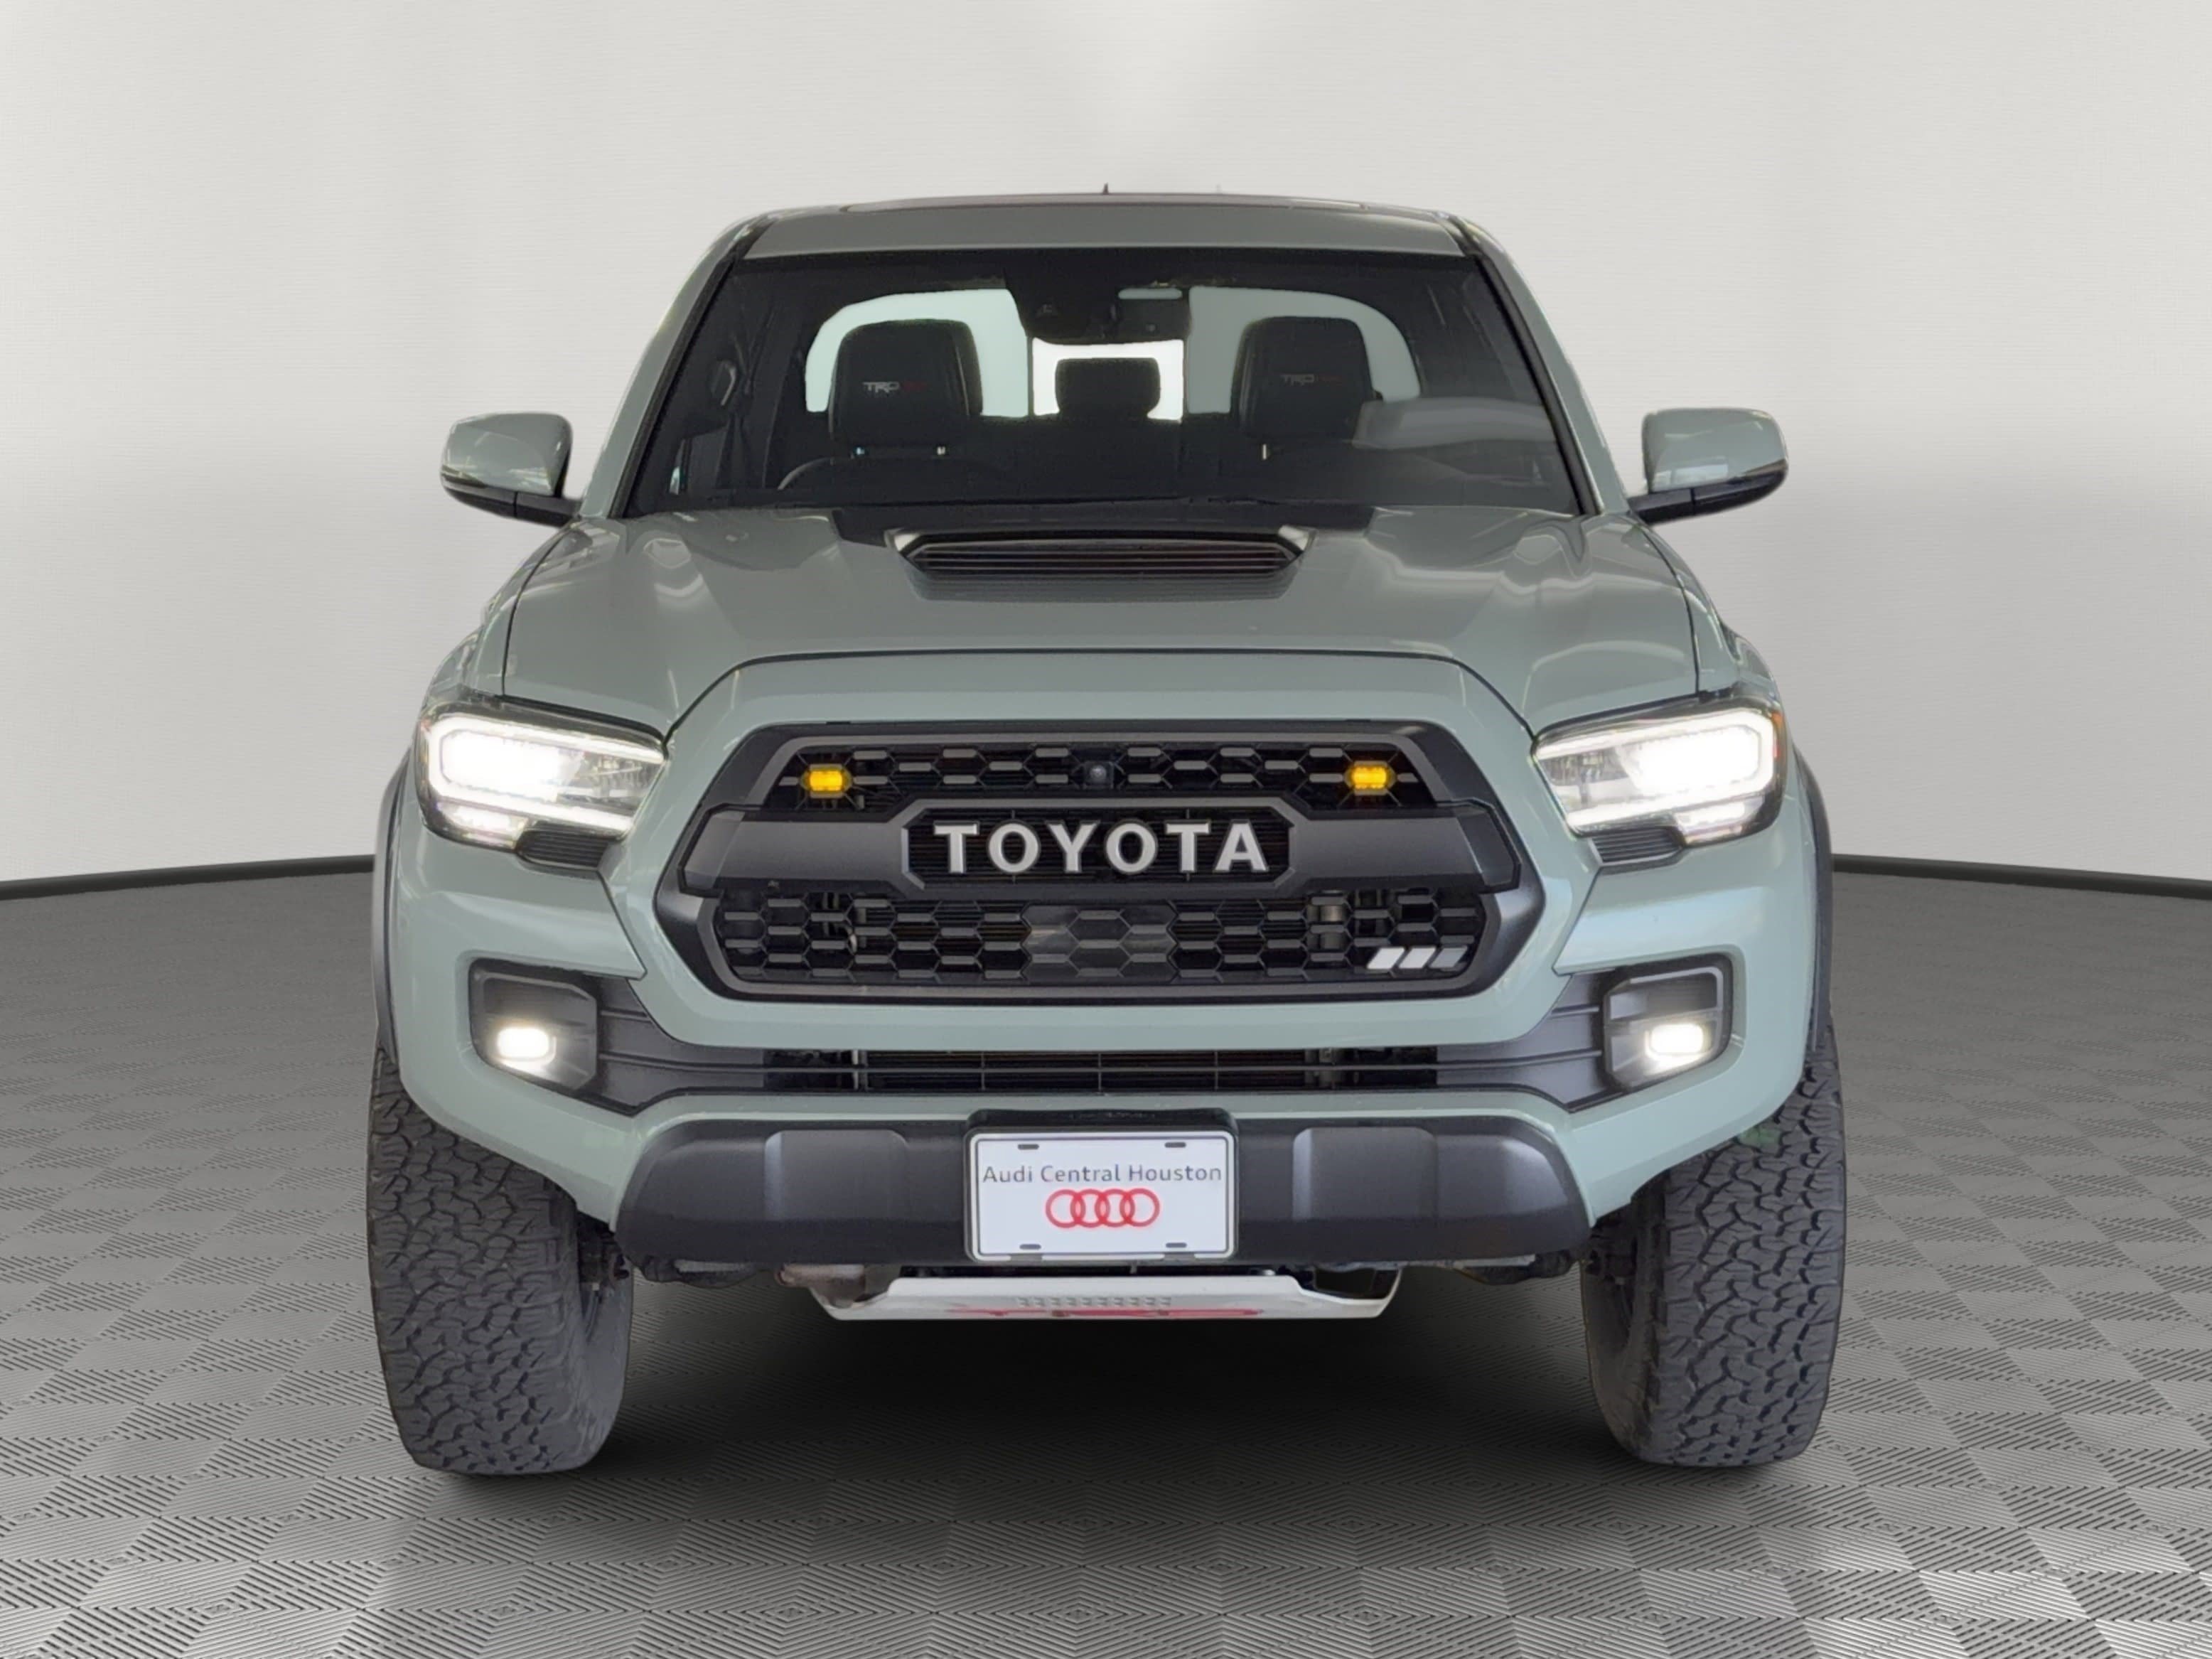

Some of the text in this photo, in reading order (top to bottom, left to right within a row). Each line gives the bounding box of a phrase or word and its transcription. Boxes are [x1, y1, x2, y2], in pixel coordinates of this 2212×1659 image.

[862, 381, 900, 393] TRD
[933, 820, 1269, 874] TOYOTA
[982, 1164, 1222, 1183] Audi Central Houston
